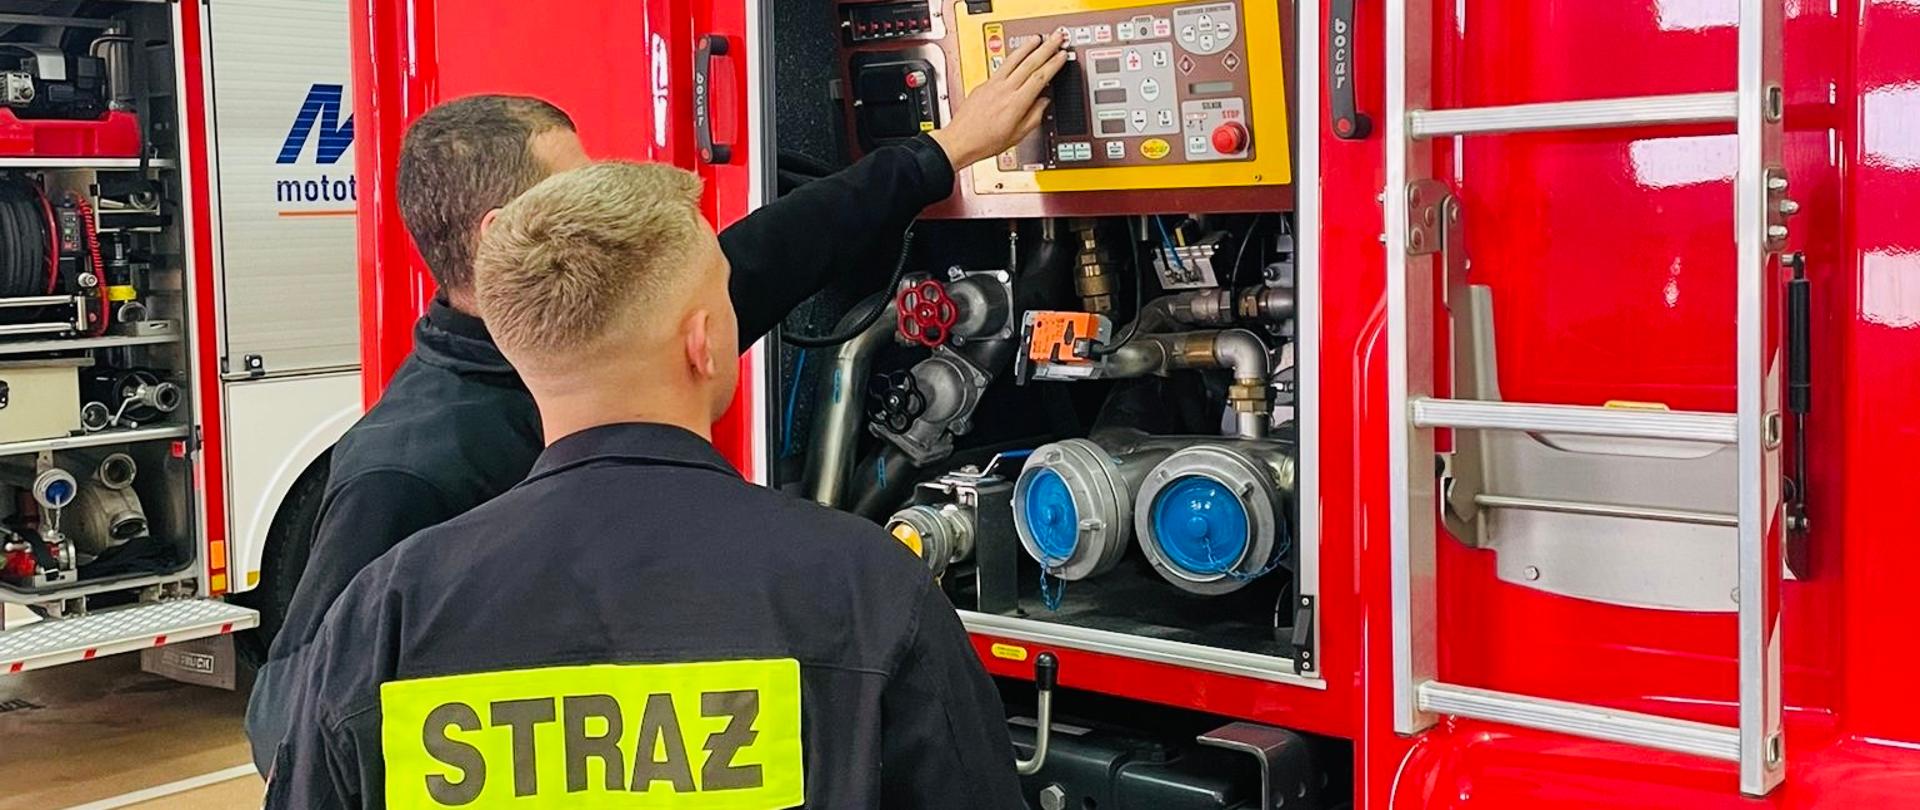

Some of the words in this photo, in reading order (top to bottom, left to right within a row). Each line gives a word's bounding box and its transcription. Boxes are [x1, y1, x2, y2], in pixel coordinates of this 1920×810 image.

[1334, 18, 1346, 89] bocar
[696, 72, 704, 127] bocar
[1222, 110, 1239, 119] STOP
